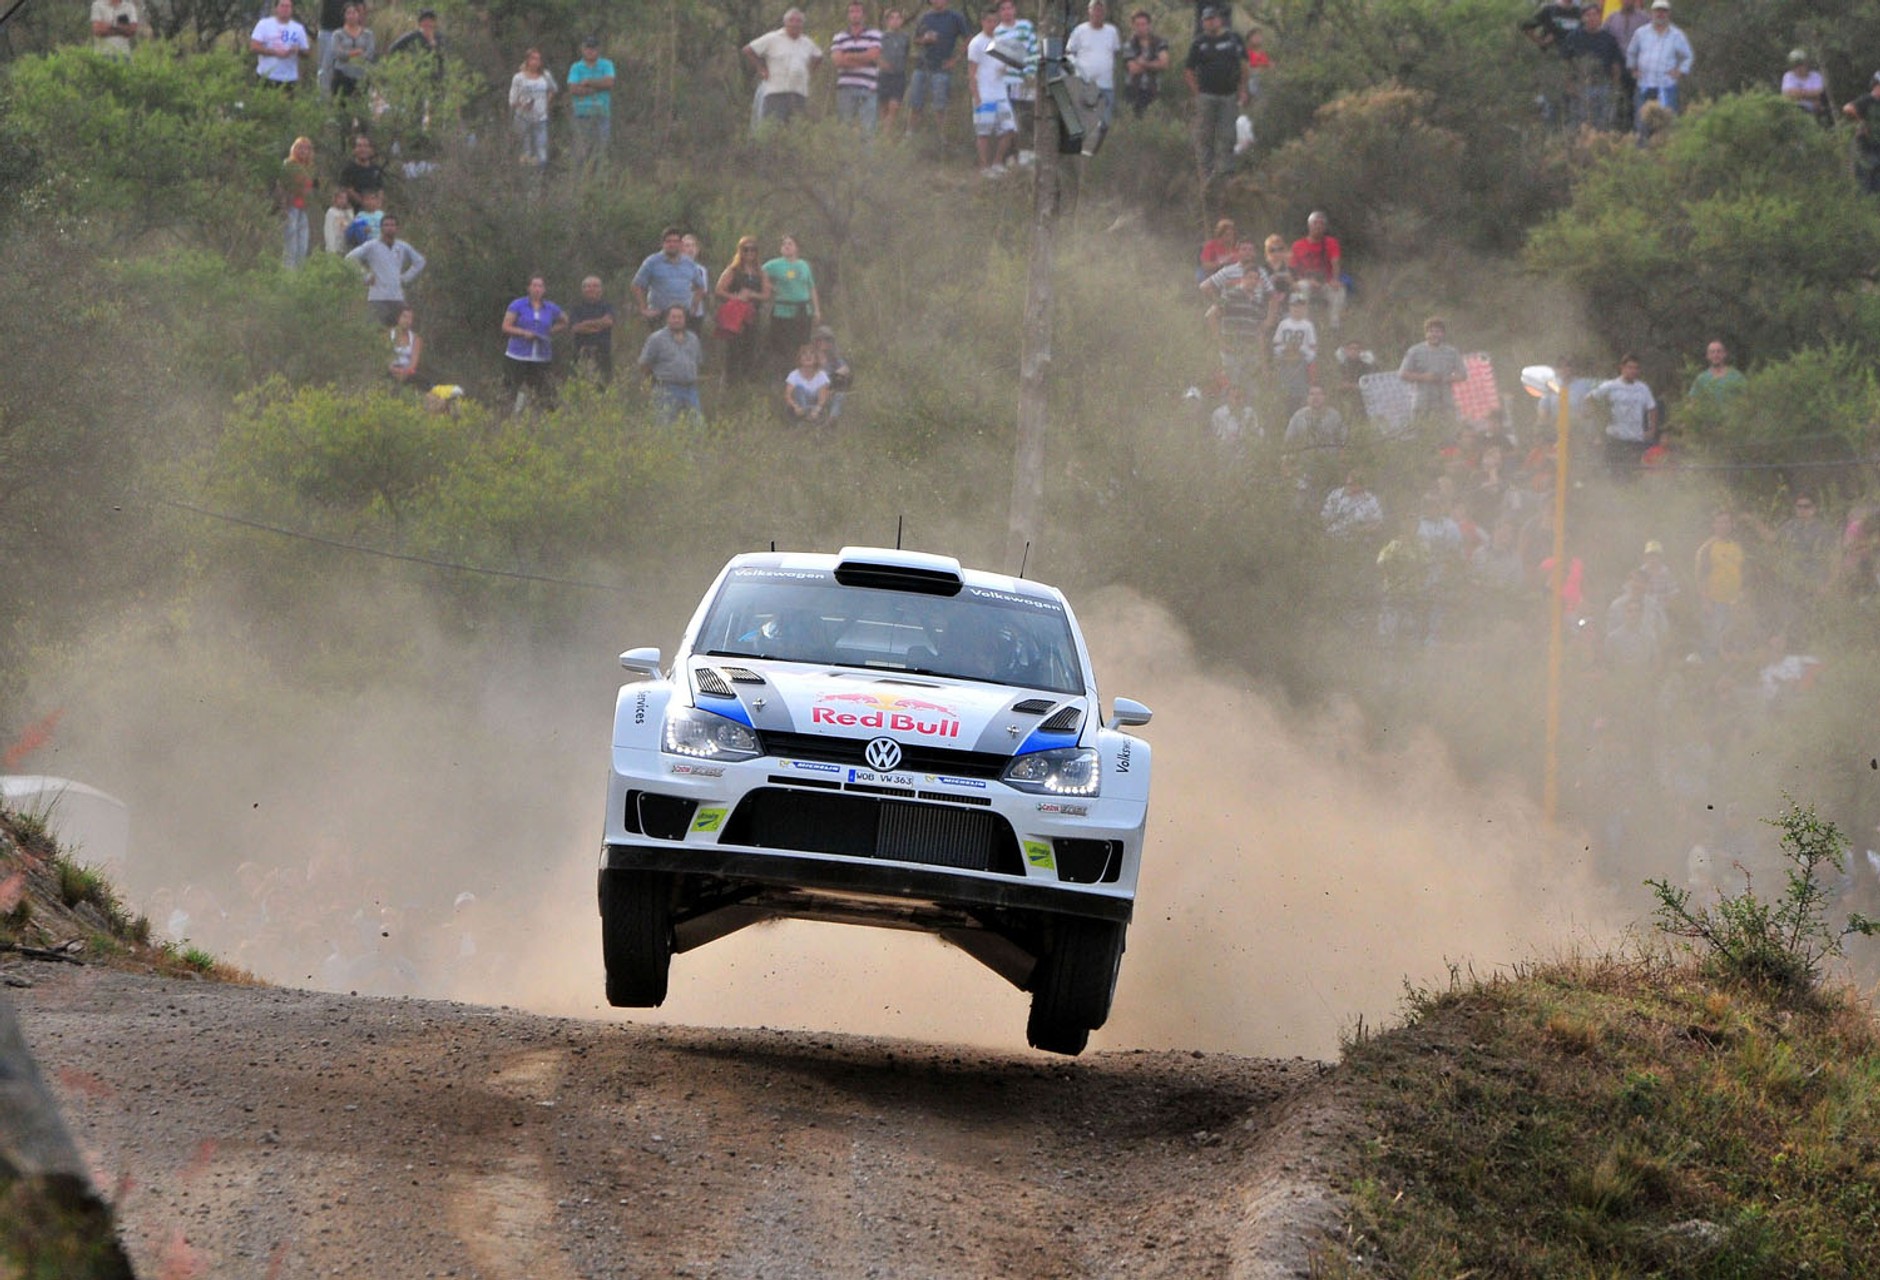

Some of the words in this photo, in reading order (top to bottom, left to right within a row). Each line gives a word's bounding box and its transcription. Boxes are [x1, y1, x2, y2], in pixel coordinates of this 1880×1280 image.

[733, 569, 825, 580] Volkswagen
[969, 587, 1062, 611] Volkswagen
[812, 707, 884, 728] Red
[890, 713, 960, 737] Bull
[797, 762, 839, 772] MICHELIN
[880, 774, 893, 783] VW
[943, 778, 985, 788] MICHELIN
